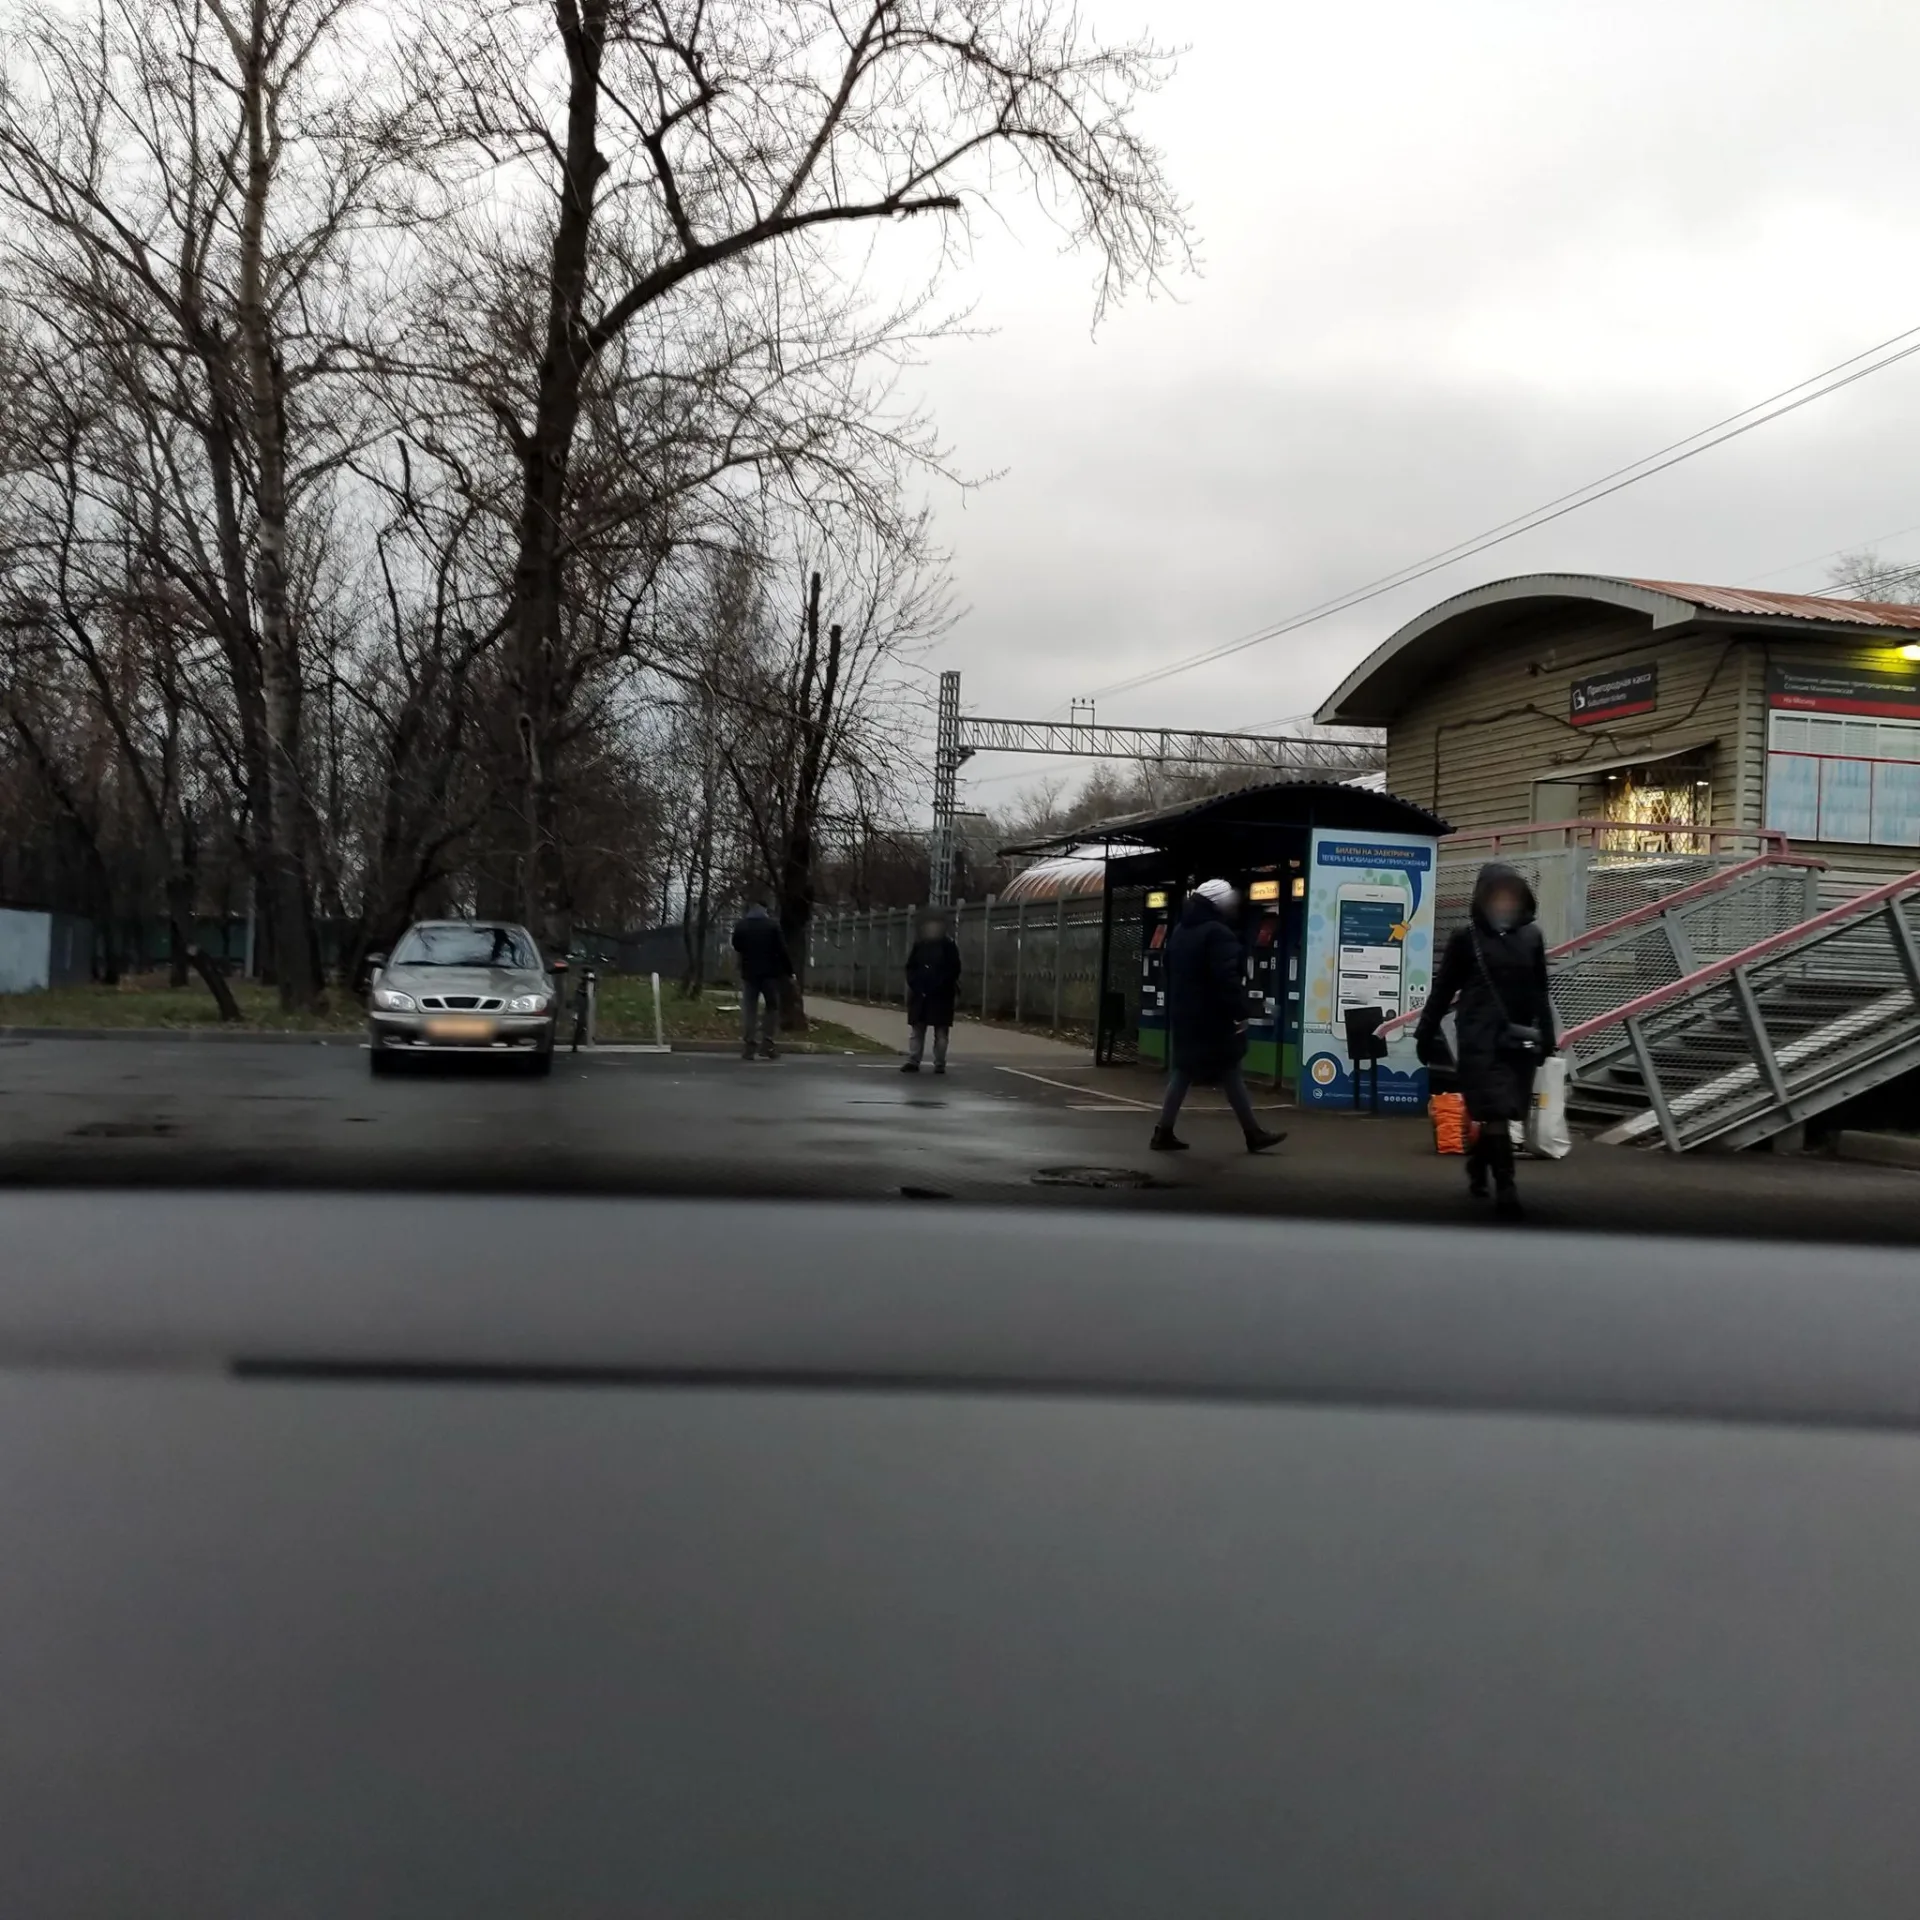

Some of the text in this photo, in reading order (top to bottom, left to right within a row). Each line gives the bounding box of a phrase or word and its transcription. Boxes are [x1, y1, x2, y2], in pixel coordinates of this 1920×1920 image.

[1335, 846, 1361, 855] БИЛЕТЫ
[1373, 849, 1415, 858] ЭЛЕКТРИЧКУ
[1321, 853, 1341, 862] ТЕПЕРЬ
[1347, 855, 1386, 864] МОБИЛЬНОМ
